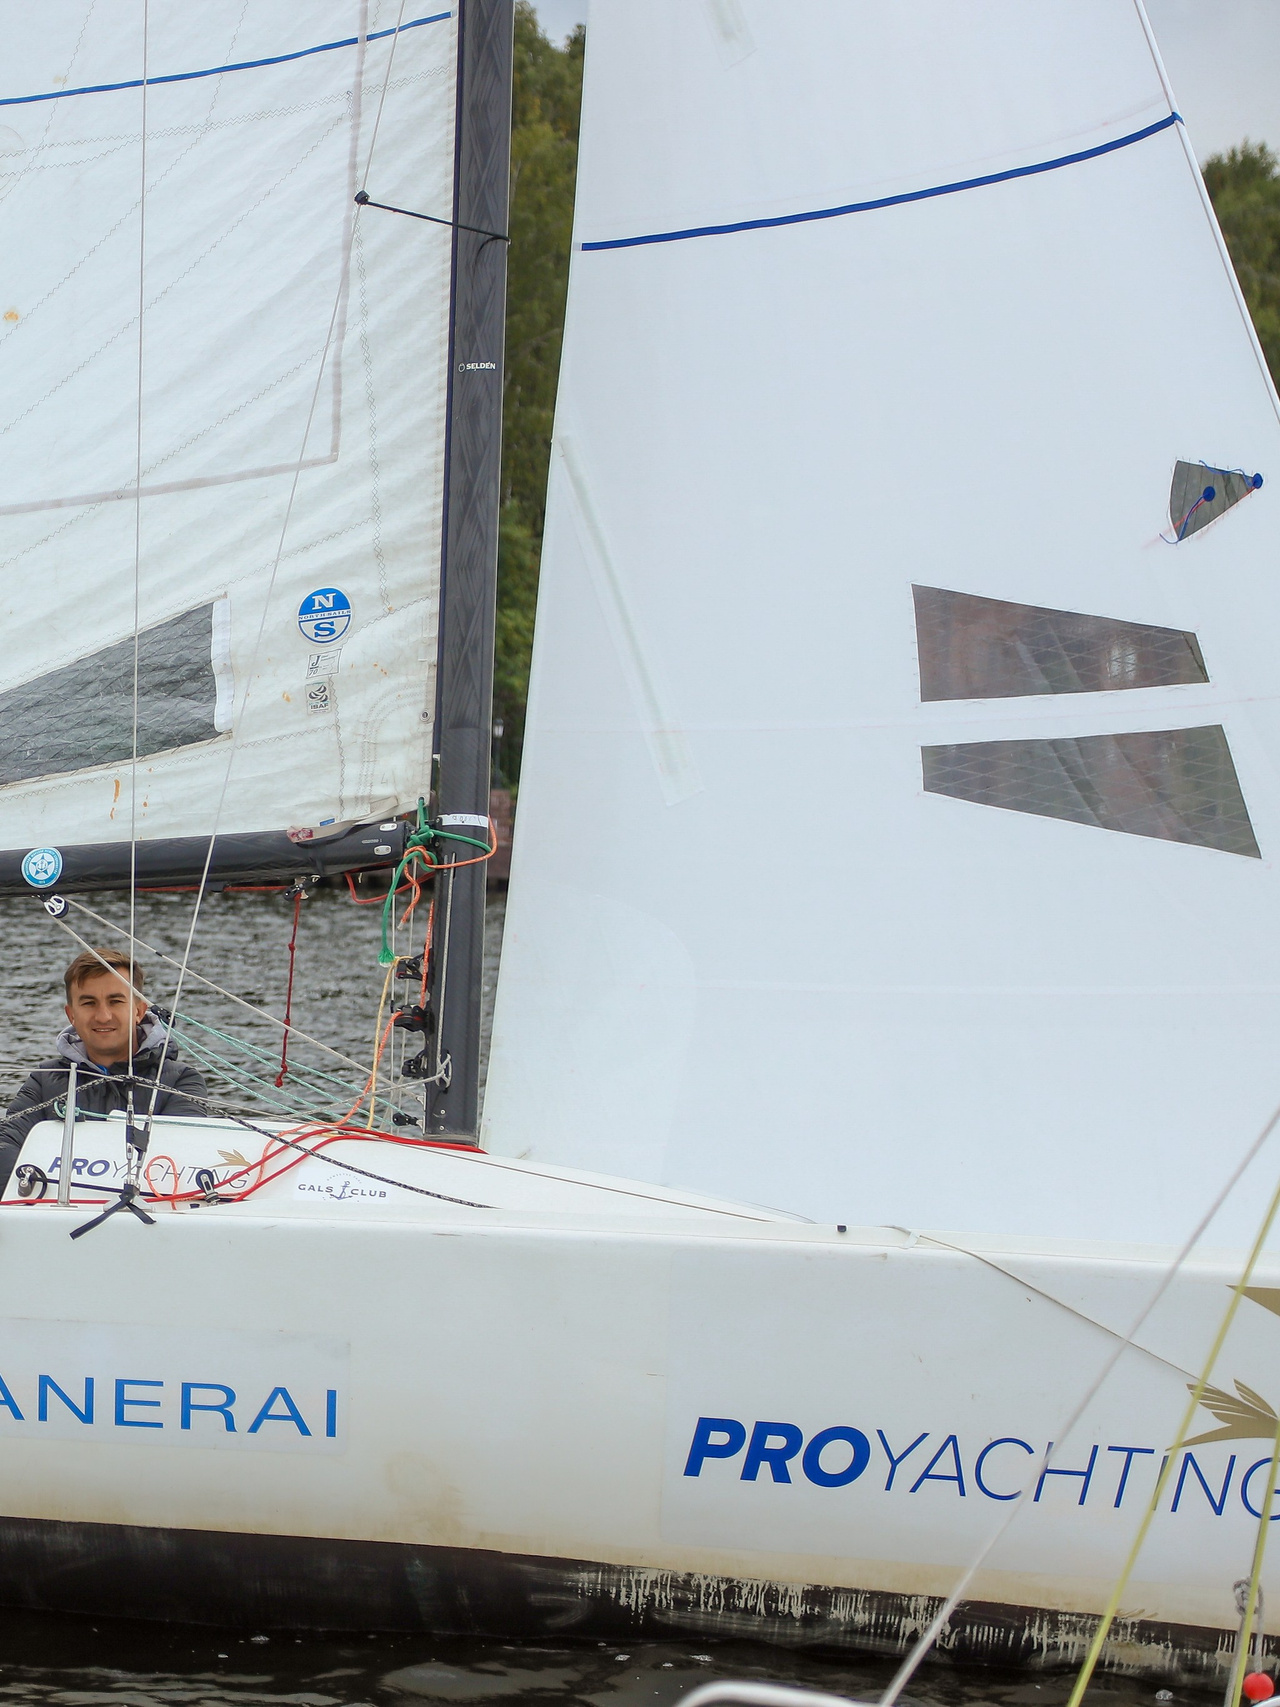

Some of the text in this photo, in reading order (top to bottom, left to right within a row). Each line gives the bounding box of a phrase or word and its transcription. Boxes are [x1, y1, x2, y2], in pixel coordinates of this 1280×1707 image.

[466, 361, 496, 370] SELDÉN
[311, 593, 337, 610] N
[313, 621, 336, 638] S
[298, 1183, 387, 1198] GALS CLUB
